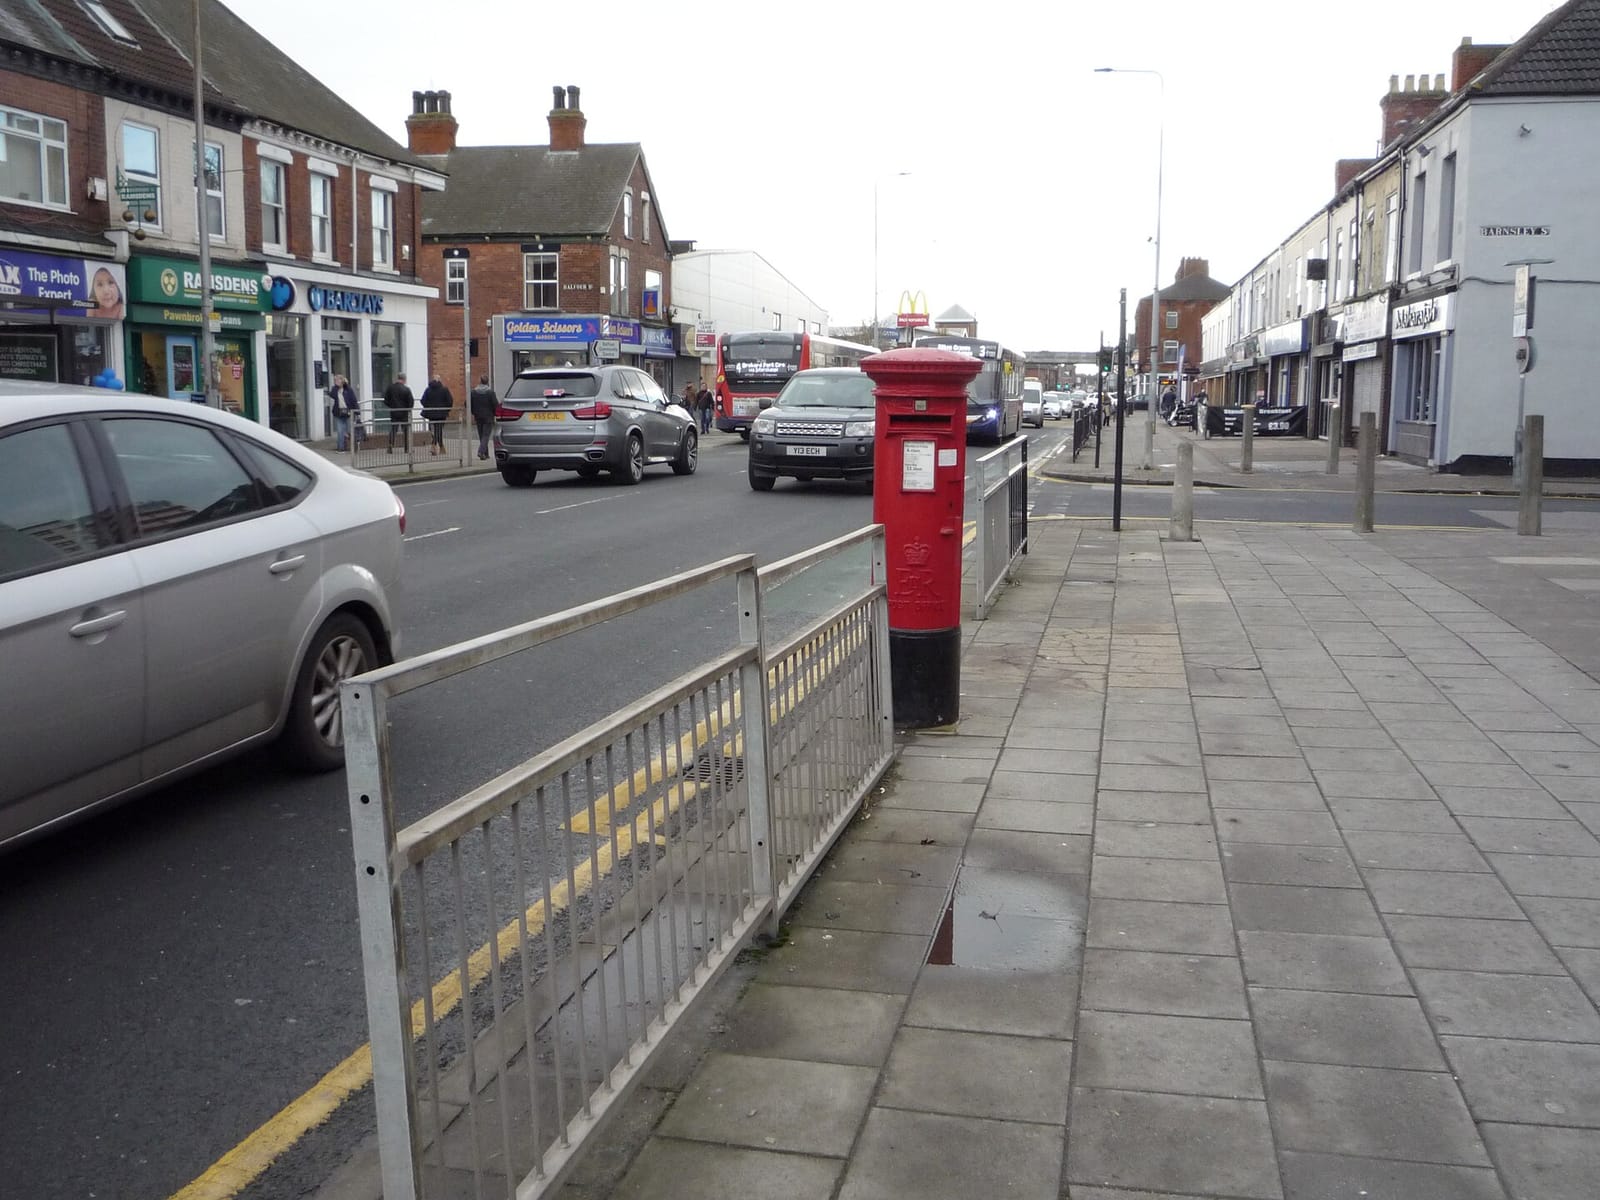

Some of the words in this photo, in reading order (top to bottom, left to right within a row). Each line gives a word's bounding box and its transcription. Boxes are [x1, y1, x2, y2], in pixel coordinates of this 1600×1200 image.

[1482, 227, 1535, 236] BARNSLEY
[28, 267, 48, 282] The
[50, 270, 80, 286] Photo
[325, 289, 384, 314] BARCLAYS
[506, 321, 540, 335] Golden
[542, 321, 583, 333] Scissors
[978, 345, 987, 357] 3
[736, 362, 742, 373] 4
[793, 447, 805, 455] Y13
[806, 447, 820, 455] ECH
